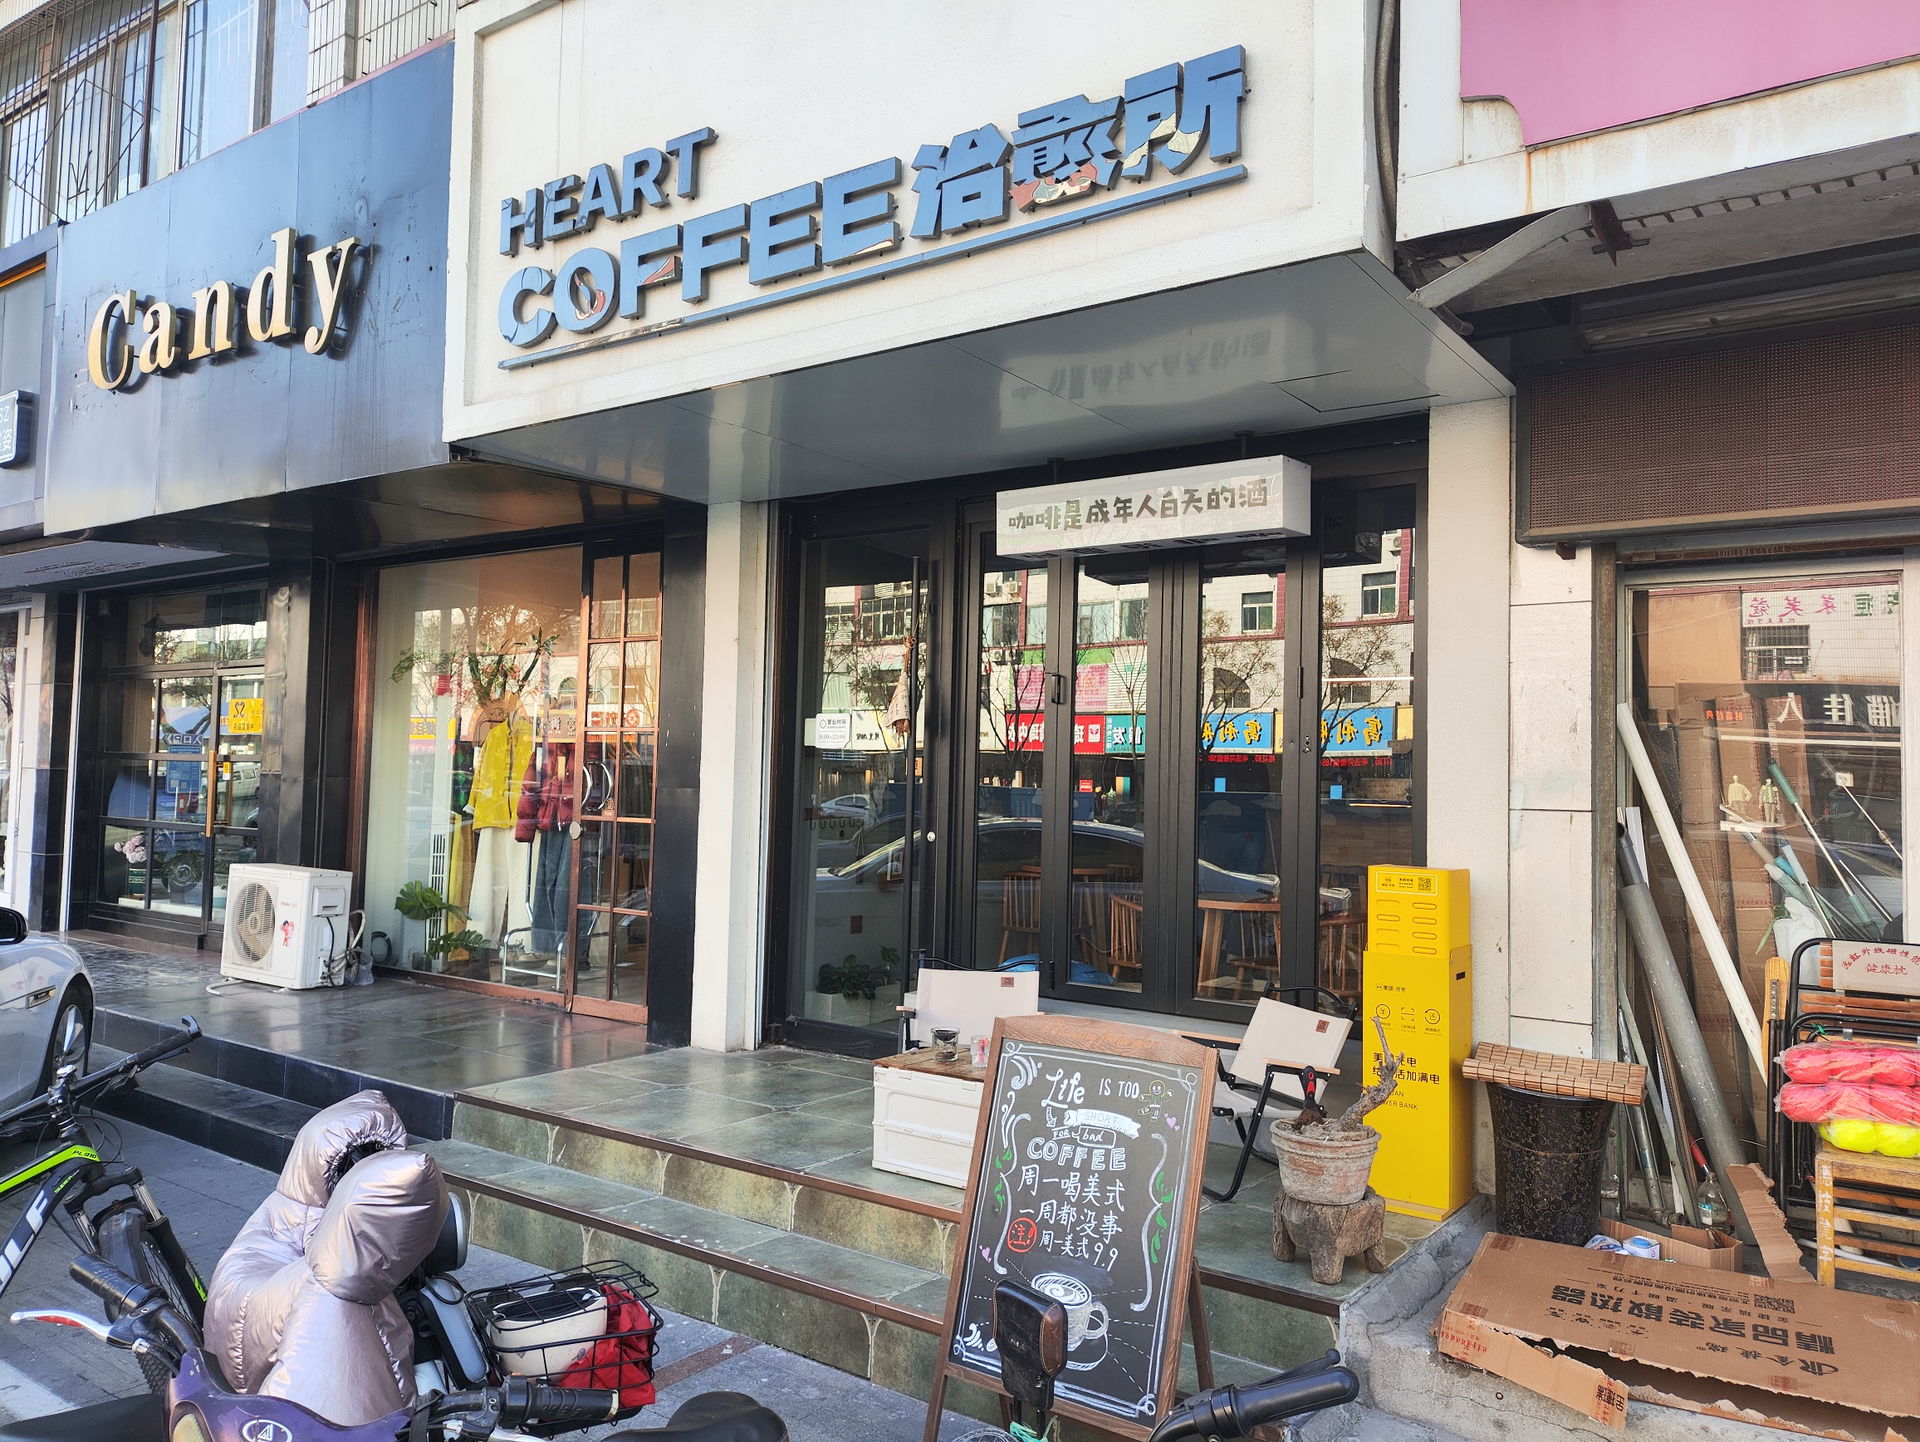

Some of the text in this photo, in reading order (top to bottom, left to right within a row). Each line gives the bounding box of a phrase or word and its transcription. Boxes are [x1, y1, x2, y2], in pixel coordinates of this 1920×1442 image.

[498, 44, 1249, 349] COFFEE 治愈所
[500, 126, 719, 258] HEART
[87, 227, 365, 391] Candy
[1008, 478, 1268, 531] 咖啡是成年人白天的酒
[1372, 1066, 1440, 1085] 给活加满电
[1373, 1052, 1417, 1068] 美充电
[1041, 1068, 1140, 1109] Life IS TOO
[1027, 1136, 1126, 1172] COFFEE
[1053, 1128, 1105, 1143] FOR bad
[1017, 1163, 1126, 1212] 周一喝美式
[1018, 1198, 1123, 1245] 一周都没事
[1550, 1283, 1835, 1356] 精品家装散热器
